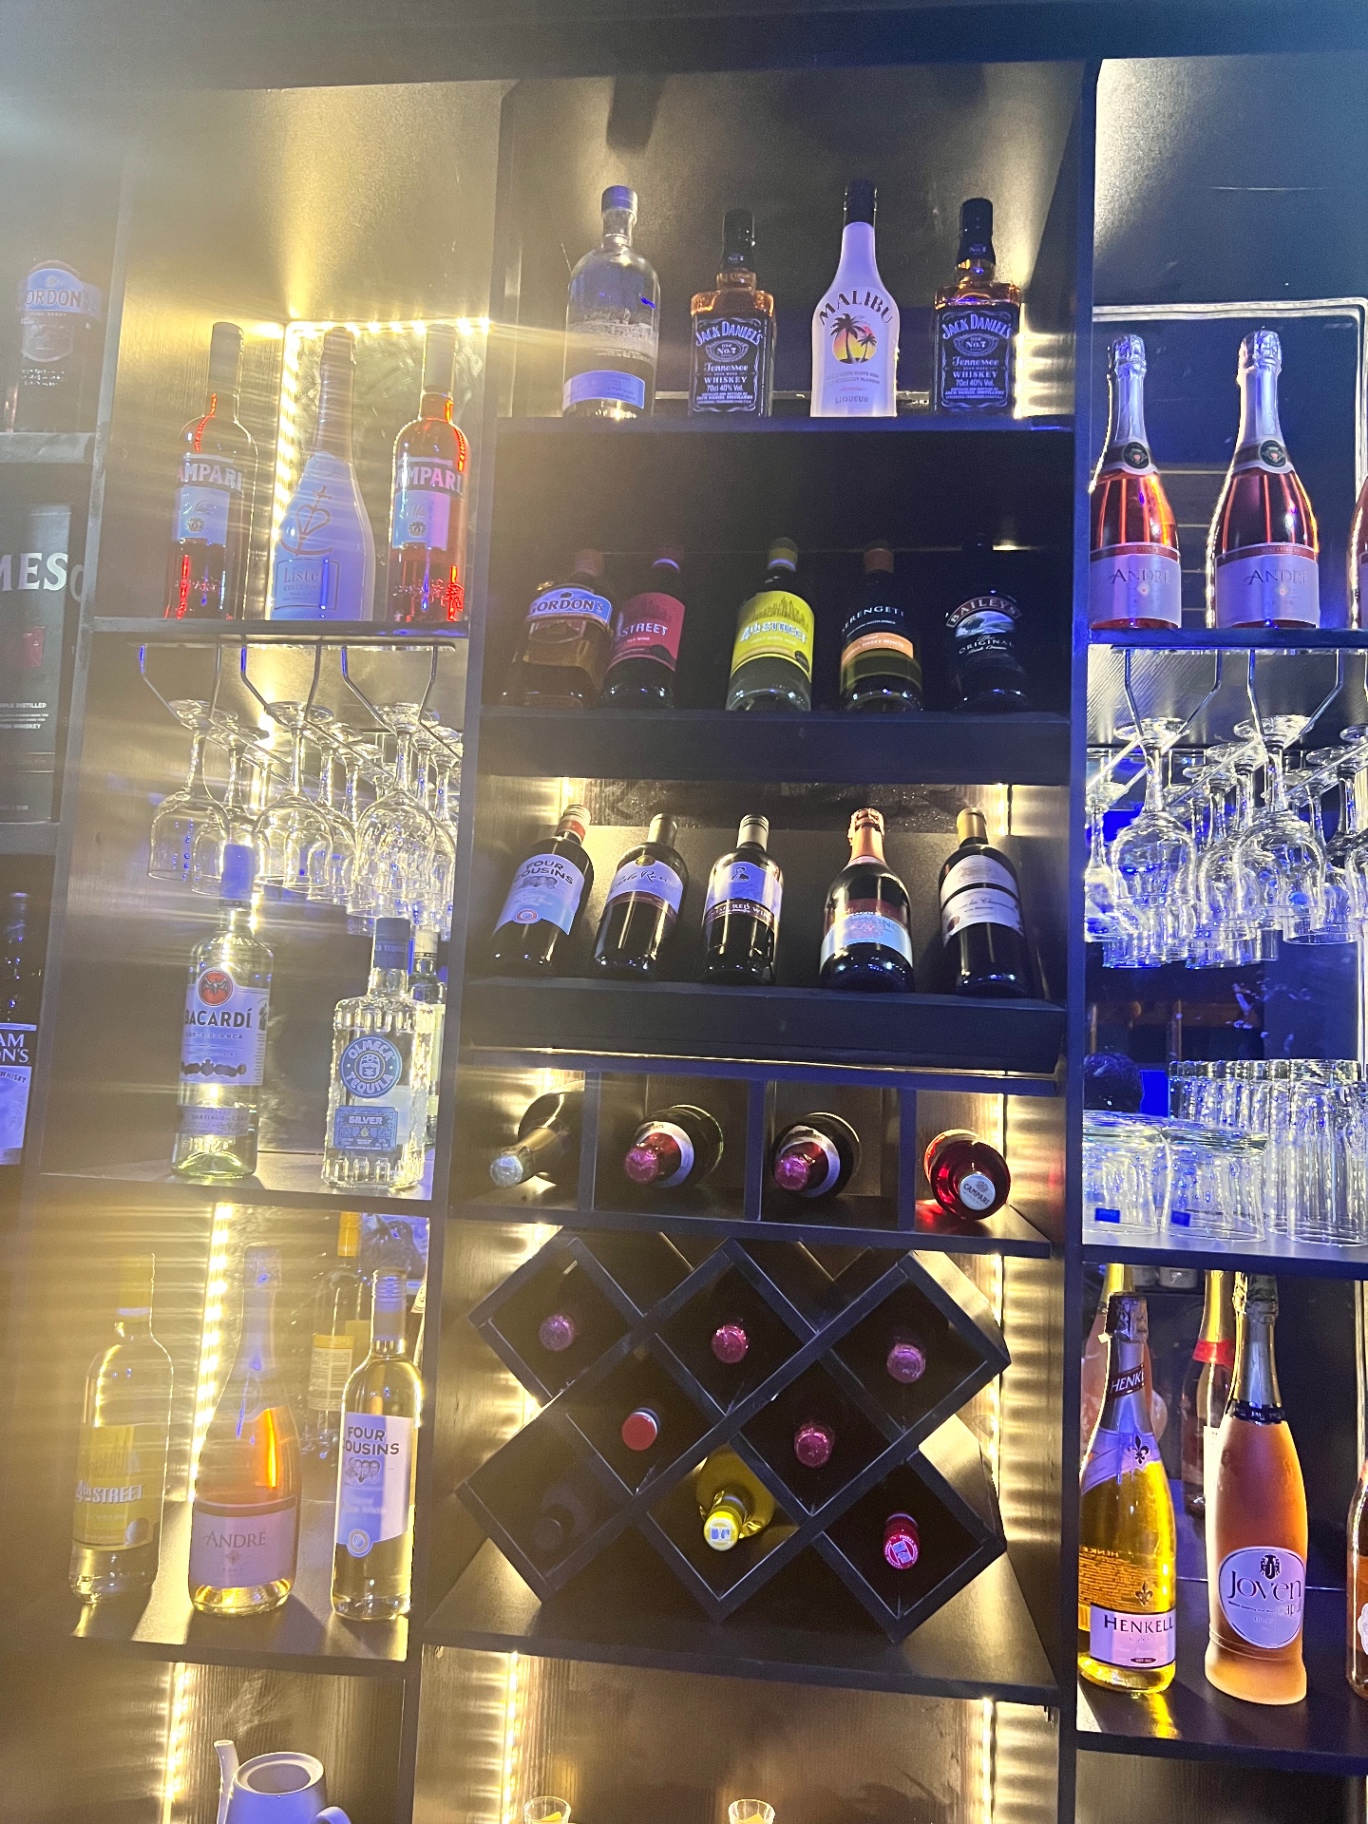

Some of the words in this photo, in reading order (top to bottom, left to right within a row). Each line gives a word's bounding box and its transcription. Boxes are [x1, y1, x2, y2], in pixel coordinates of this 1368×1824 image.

[819, 290, 893, 325] MALIBU
[695, 326, 721, 347] JACK
[721, 320, 763, 345] DANIEL'S
[941, 317, 969, 340] JACK
[970, 313, 1012, 339] DANIEL'S
[965, 341, 987, 349] No.7
[704, 362, 749, 373] Tennessee
[952, 356, 999, 367] Tennessee
[176, 463, 243, 491] AMPARI
[394, 466, 462, 493] AMPARI
[284, 567, 320, 583] Liste
[531, 598, 604, 616] GORDONS
[950, 599, 1016, 623] BAILEYS
[621, 621, 669, 637] STREET
[958, 639, 1015, 654] ORIGINAL
[526, 859, 564, 872] FOUR
[185, 1007, 253, 1029] BACARDÍ
[0, 1048, 29, 1063] N'S
[349, 1039, 391, 1061] OLMECA
[344, 1071, 394, 1095] TEQUILA
[348, 1115, 383, 1125] SILVER
[963, 1183, 991, 1206] CAMPARI
[1110, 1370, 1144, 1394] HENK
[347, 1426, 385, 1442] FOUR
[92, 1484, 144, 1504] STREET
[1226, 1569, 1302, 1602] Joven
[1103, 1614, 1174, 1634] HENKELL
